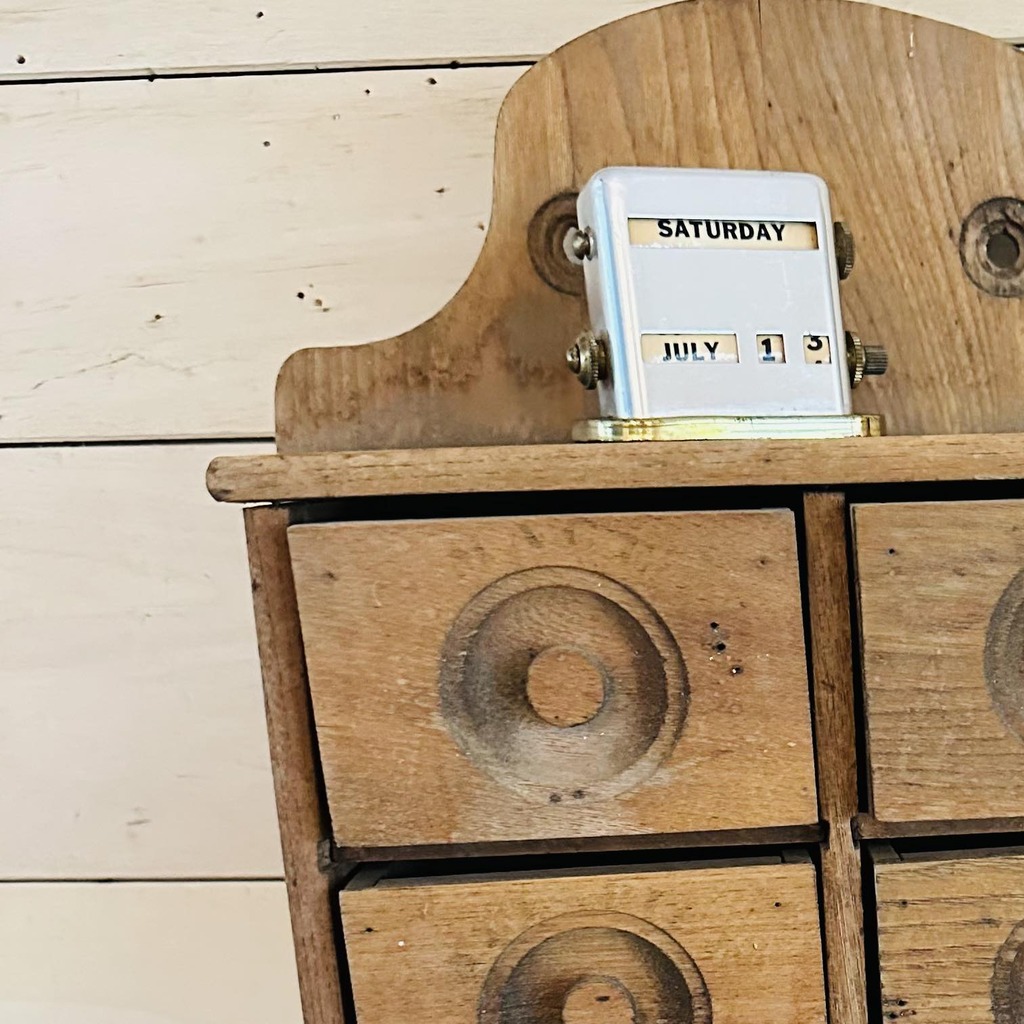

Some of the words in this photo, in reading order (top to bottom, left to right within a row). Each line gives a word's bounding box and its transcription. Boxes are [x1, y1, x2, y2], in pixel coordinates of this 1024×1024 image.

[657, 219, 786, 241] SATURDAY
[662, 342, 718, 362] JULY
[761, 338, 776, 361] 1
